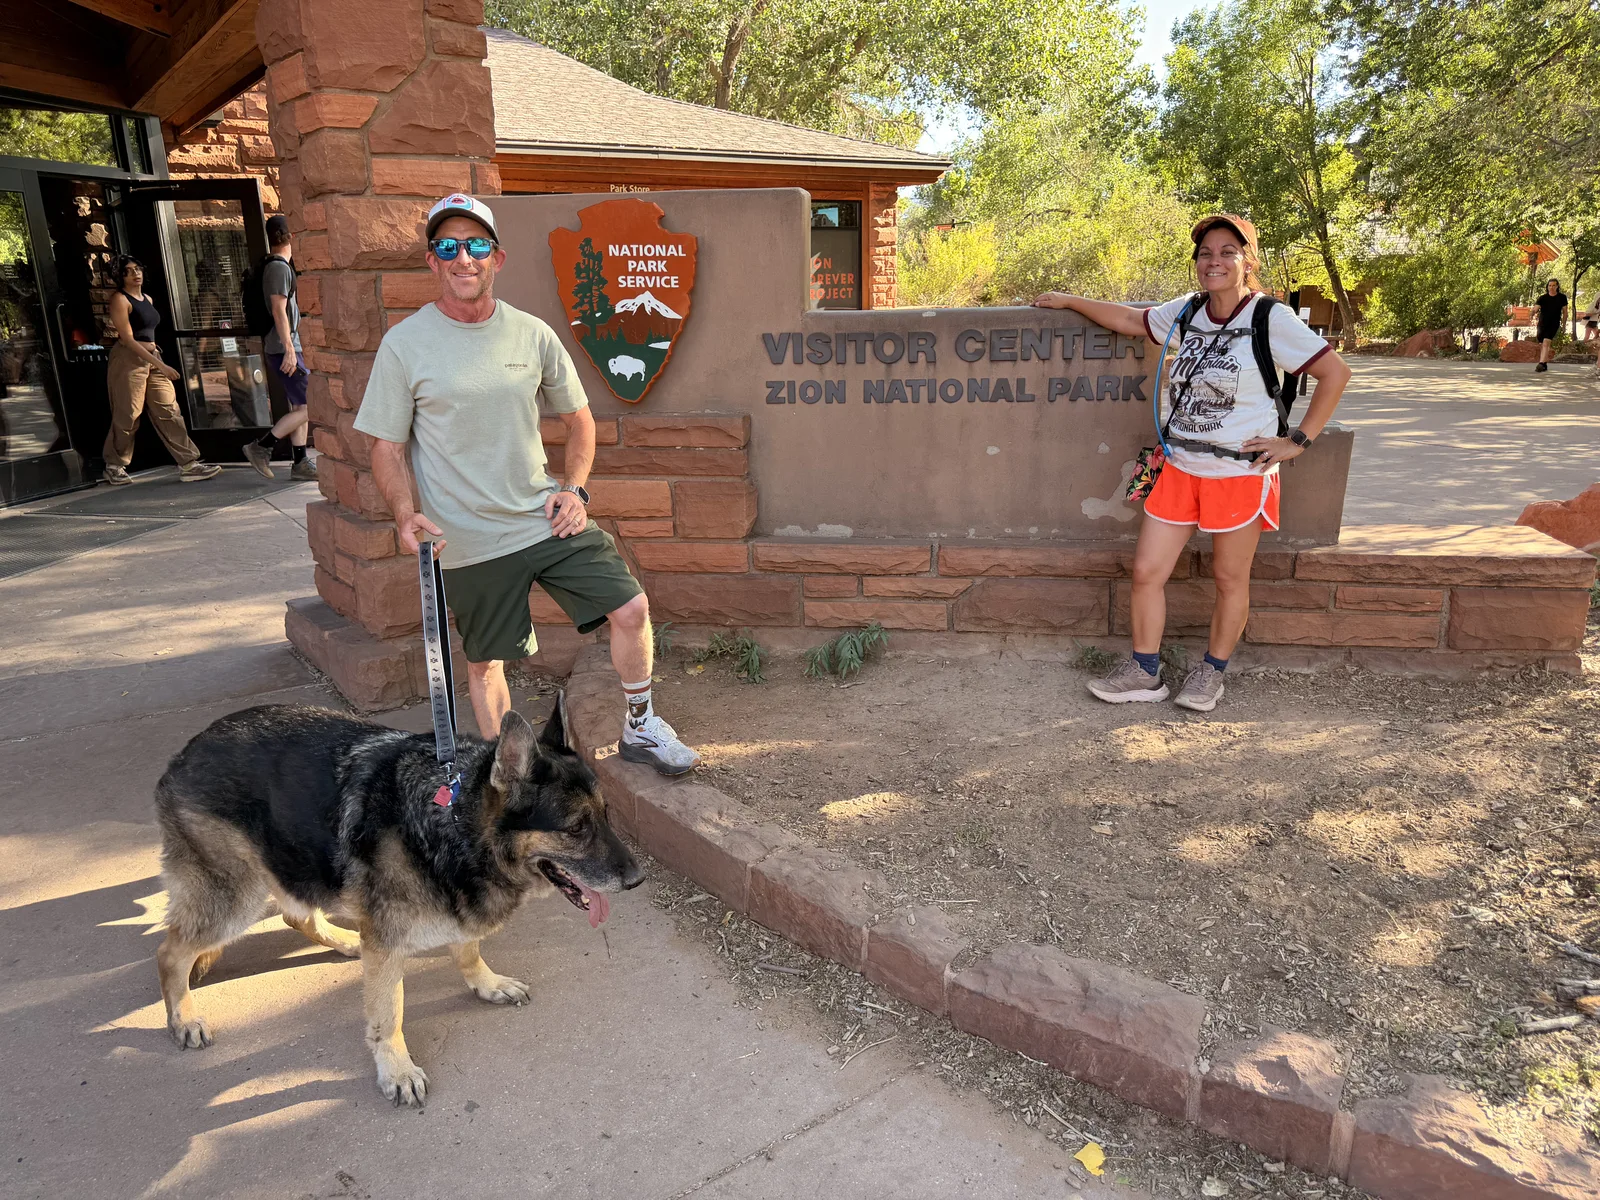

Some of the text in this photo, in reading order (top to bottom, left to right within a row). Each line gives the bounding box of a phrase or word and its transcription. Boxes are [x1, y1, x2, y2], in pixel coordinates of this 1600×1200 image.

[610, 184, 651, 193] Park Store
[608, 244, 687, 257] NATIONAL
[627, 260, 668, 273] PARK
[810, 257, 832, 270] ION
[617, 275, 680, 288] SERVICE
[810, 272, 855, 286] OREVER
[810, 287, 854, 300] ROJECT
[762, 326, 1145, 365] VISITOR CENTER
[1170, 356, 1239, 379] Muntain
[765, 375, 1148, 404] ZION NATIONAL PARK
[1199, 420, 1224, 433] PARK
